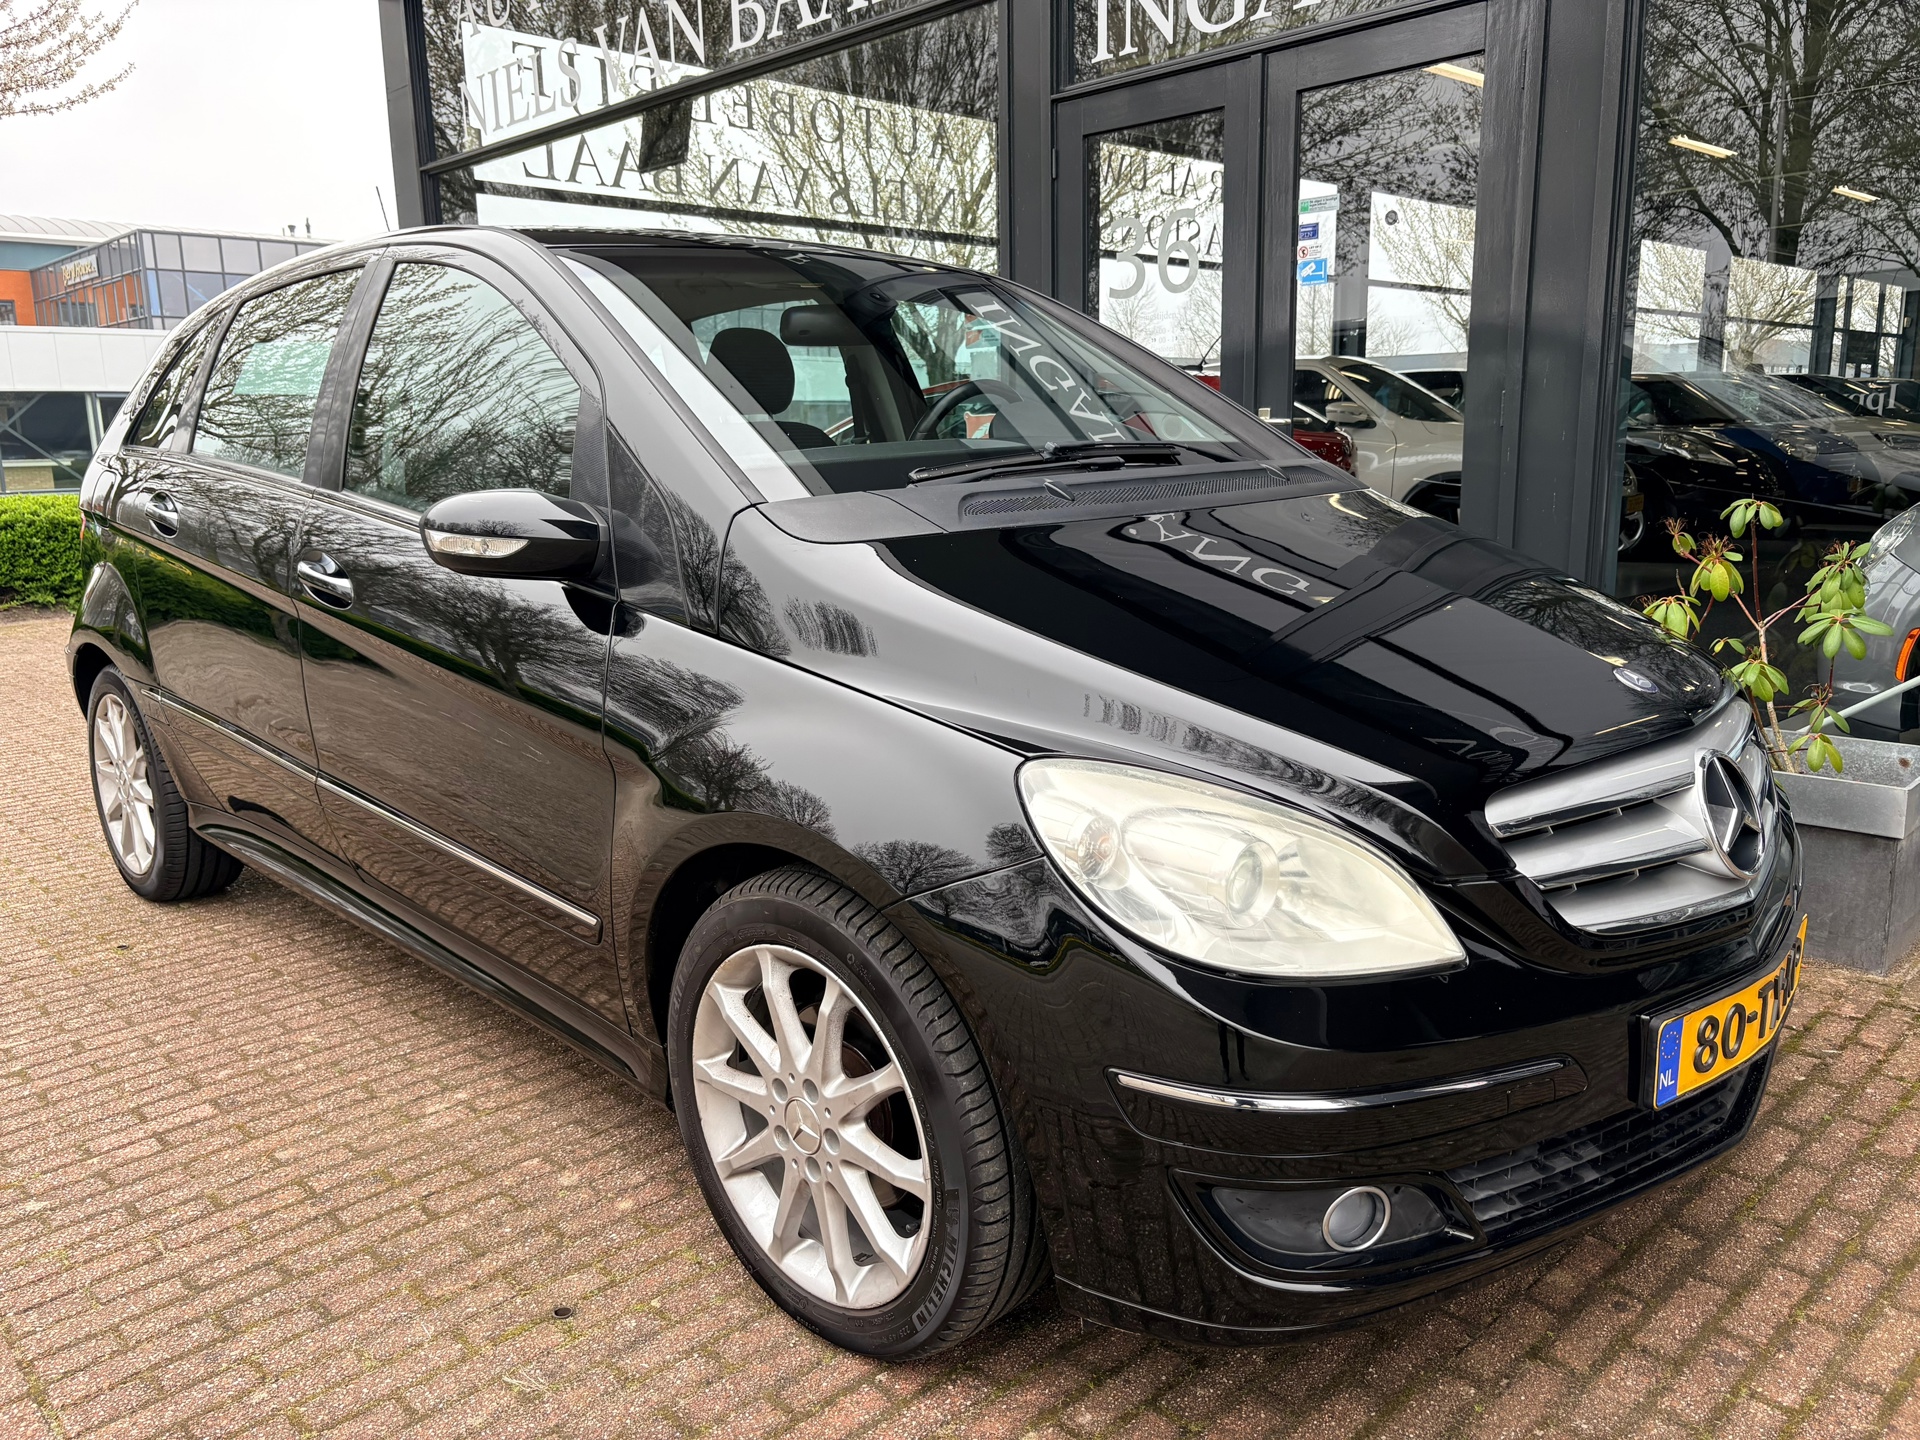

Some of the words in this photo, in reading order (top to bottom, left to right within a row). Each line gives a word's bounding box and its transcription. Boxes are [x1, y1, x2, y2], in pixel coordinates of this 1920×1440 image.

[458, 38, 582, 141] NIELS
[593, 0, 705, 92] VAN
[1108, 208, 1199, 299] 36
[1659, 1069, 1675, 1090] NL
[915, 1234, 958, 1328] MICHELIN
